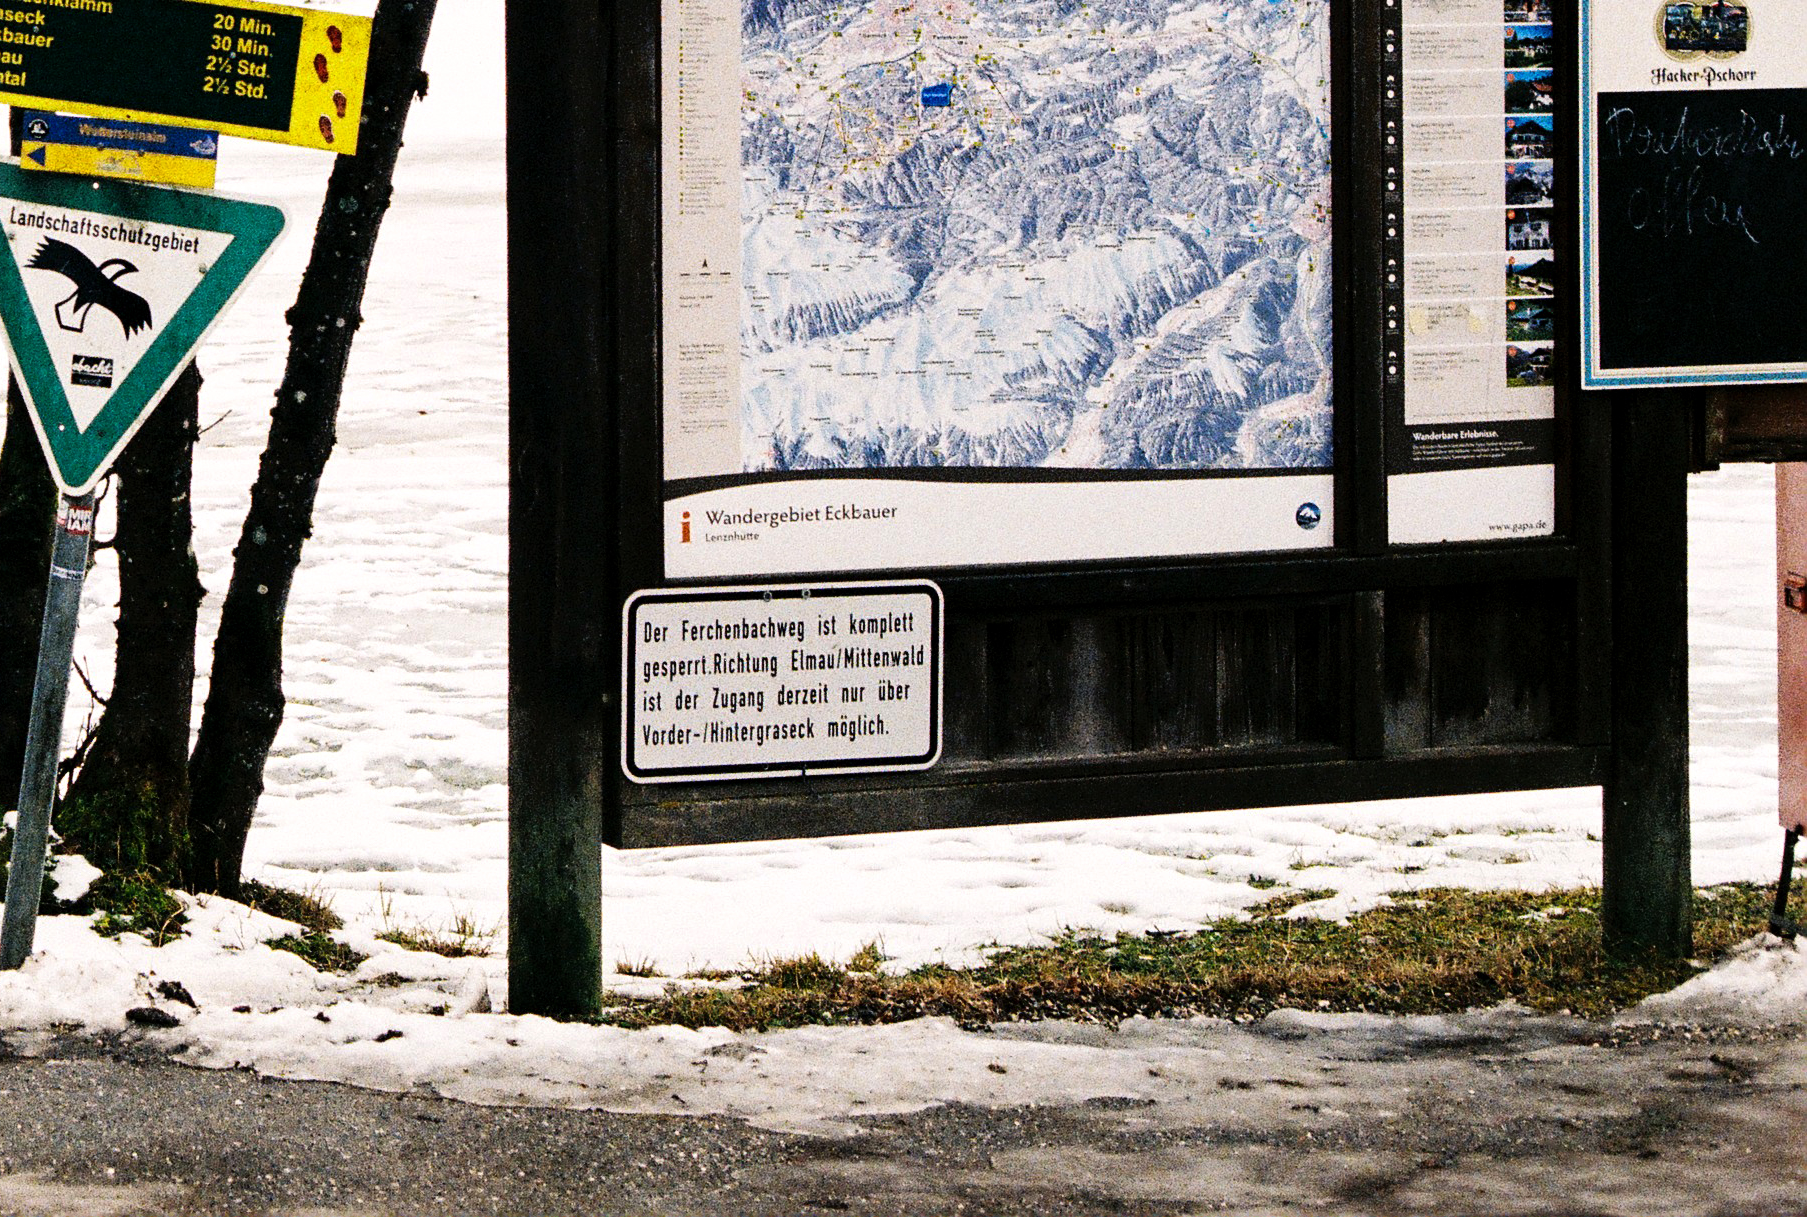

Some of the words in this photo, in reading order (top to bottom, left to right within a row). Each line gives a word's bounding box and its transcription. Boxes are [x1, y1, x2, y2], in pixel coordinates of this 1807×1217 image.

[213, 13, 235, 31] 20
[239, 16, 276, 36] Min.
[211, 34, 232, 52] 30
[236, 37, 274, 57] Min.
[237, 58, 271, 78] Std.
[1650, 66, 1757, 87] Hacker-Pschorr
[234, 79, 268, 99] Std.
[9, 205, 200, 255] Landschaftsschutzgebiet
[705, 508, 821, 528] Wandergebiet
[825, 505, 898, 521] Eckbauer
[643, 622, 668, 643] Der
[682, 617, 805, 642] Ferchenbachweg
[818, 614, 836, 636] ist
[849, 612, 914, 639] komplett
[792, 645, 925, 672] Elmau/Mittenwald
[643, 690, 662, 712] ist
[675, 689, 699, 710] der
[713, 687, 764, 713] Zugang
[777, 682, 829, 706] derzeit
[841, 685, 865, 703] nur
[878, 680, 911, 701] über
[643, 718, 815, 746] Vorder-/Hintergraseck
[828, 714, 890, 741] möglich.
